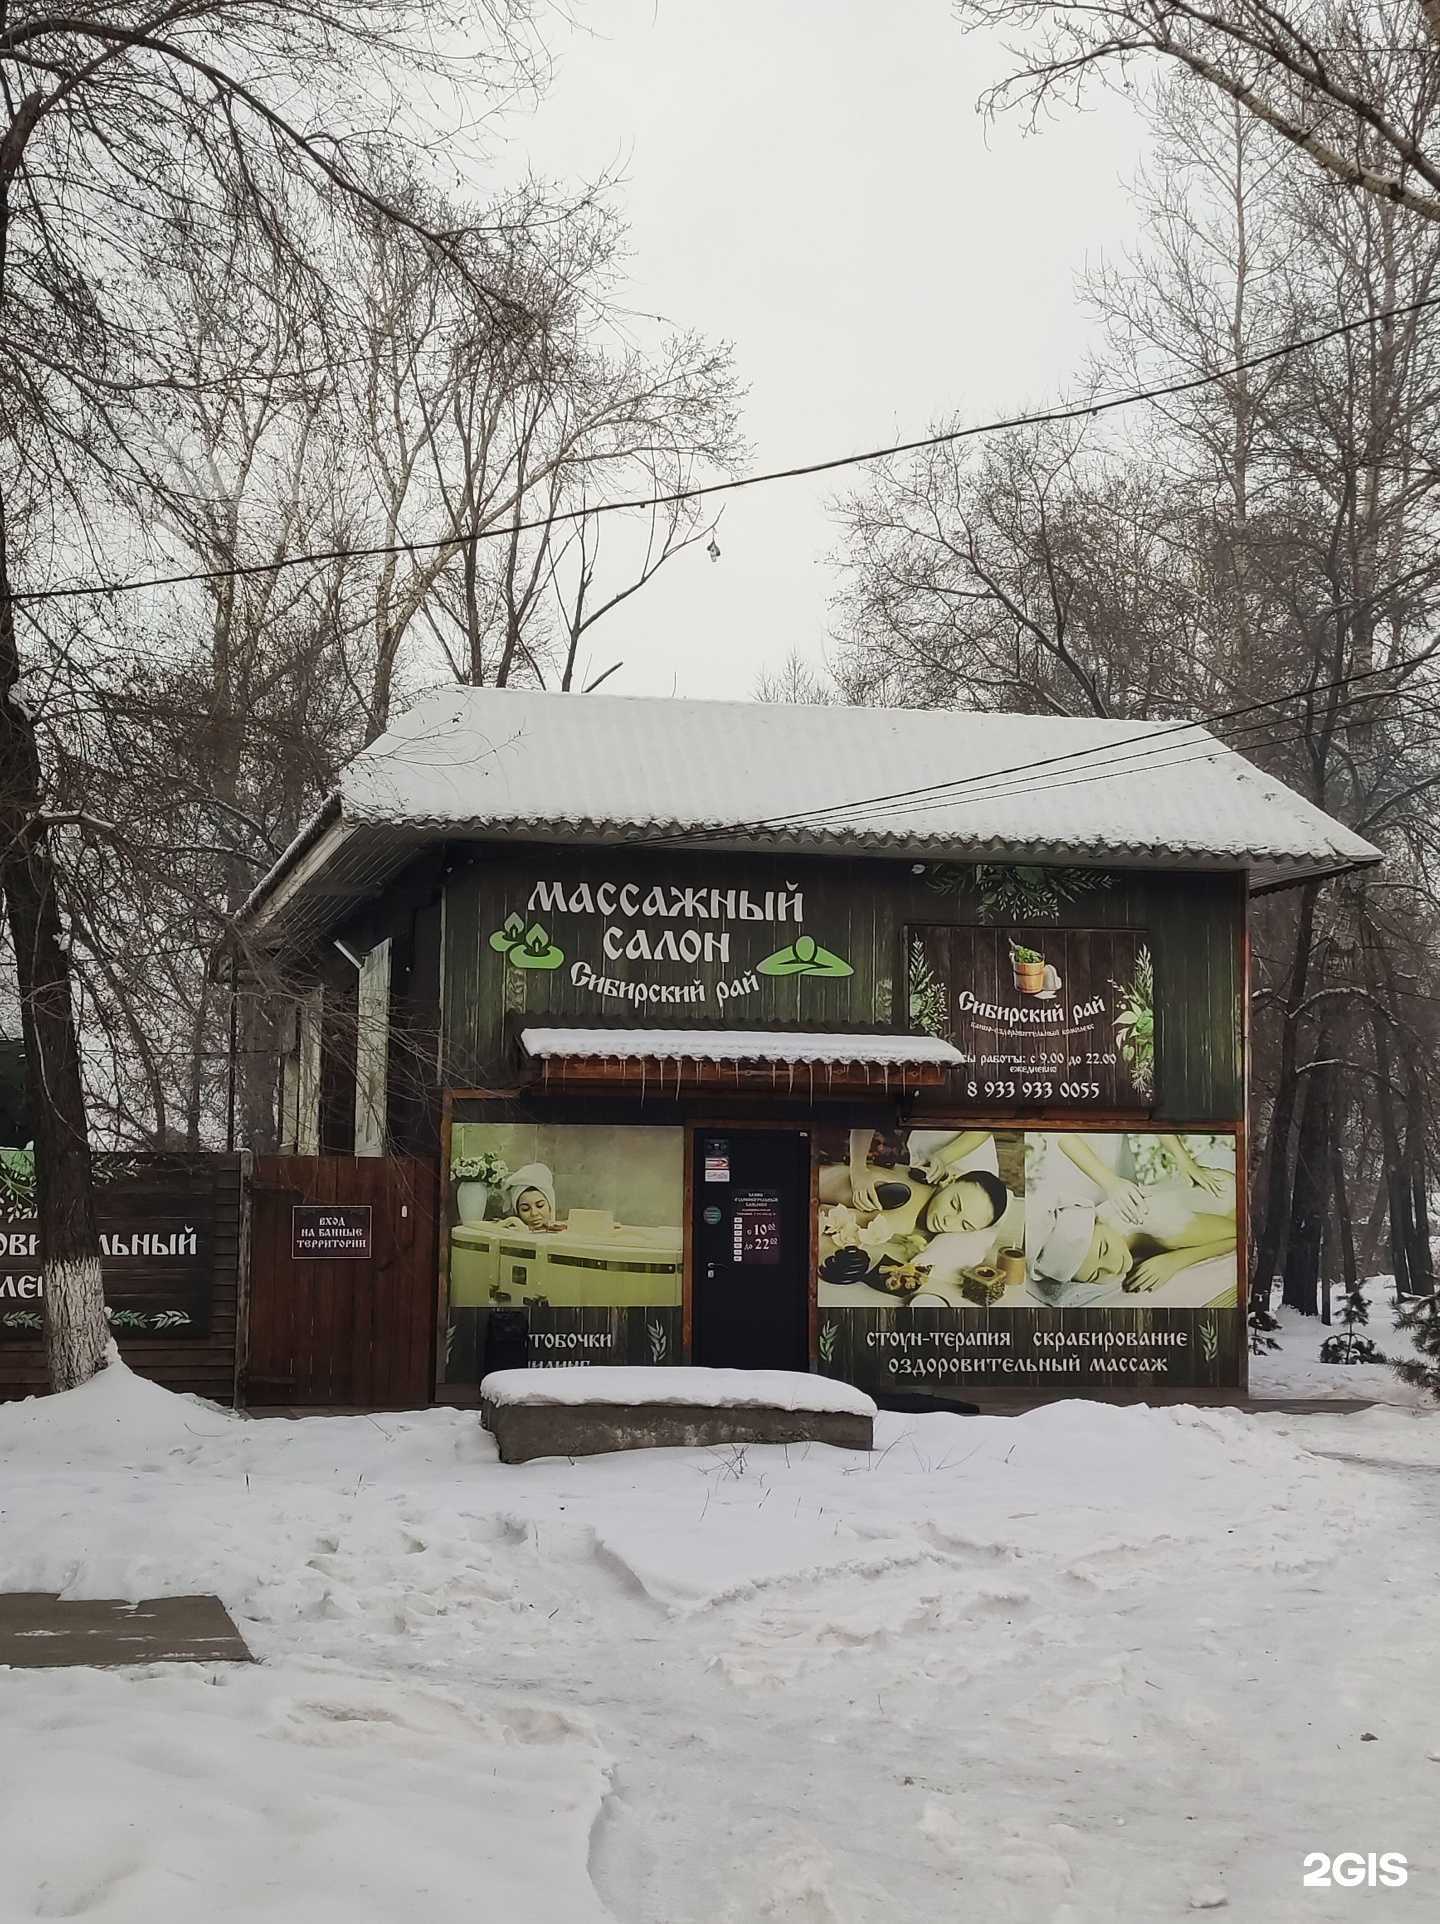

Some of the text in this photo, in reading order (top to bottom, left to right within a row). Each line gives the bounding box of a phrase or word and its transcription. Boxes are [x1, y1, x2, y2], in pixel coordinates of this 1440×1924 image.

[570, 961, 760, 1008] Сибирский рай
[958, 990, 1106, 1028] Сибирский рай
[1040, 1052, 1065, 1064] 9.00
[1068, 1056, 1082, 1066] до
[1085, 1053, 1117, 1065] 22.00
[967, 1081, 1100, 1099] 8 933 933 0055
[754, 1224, 768, 1236] 10
[755, 1238, 769, 1250] 22
